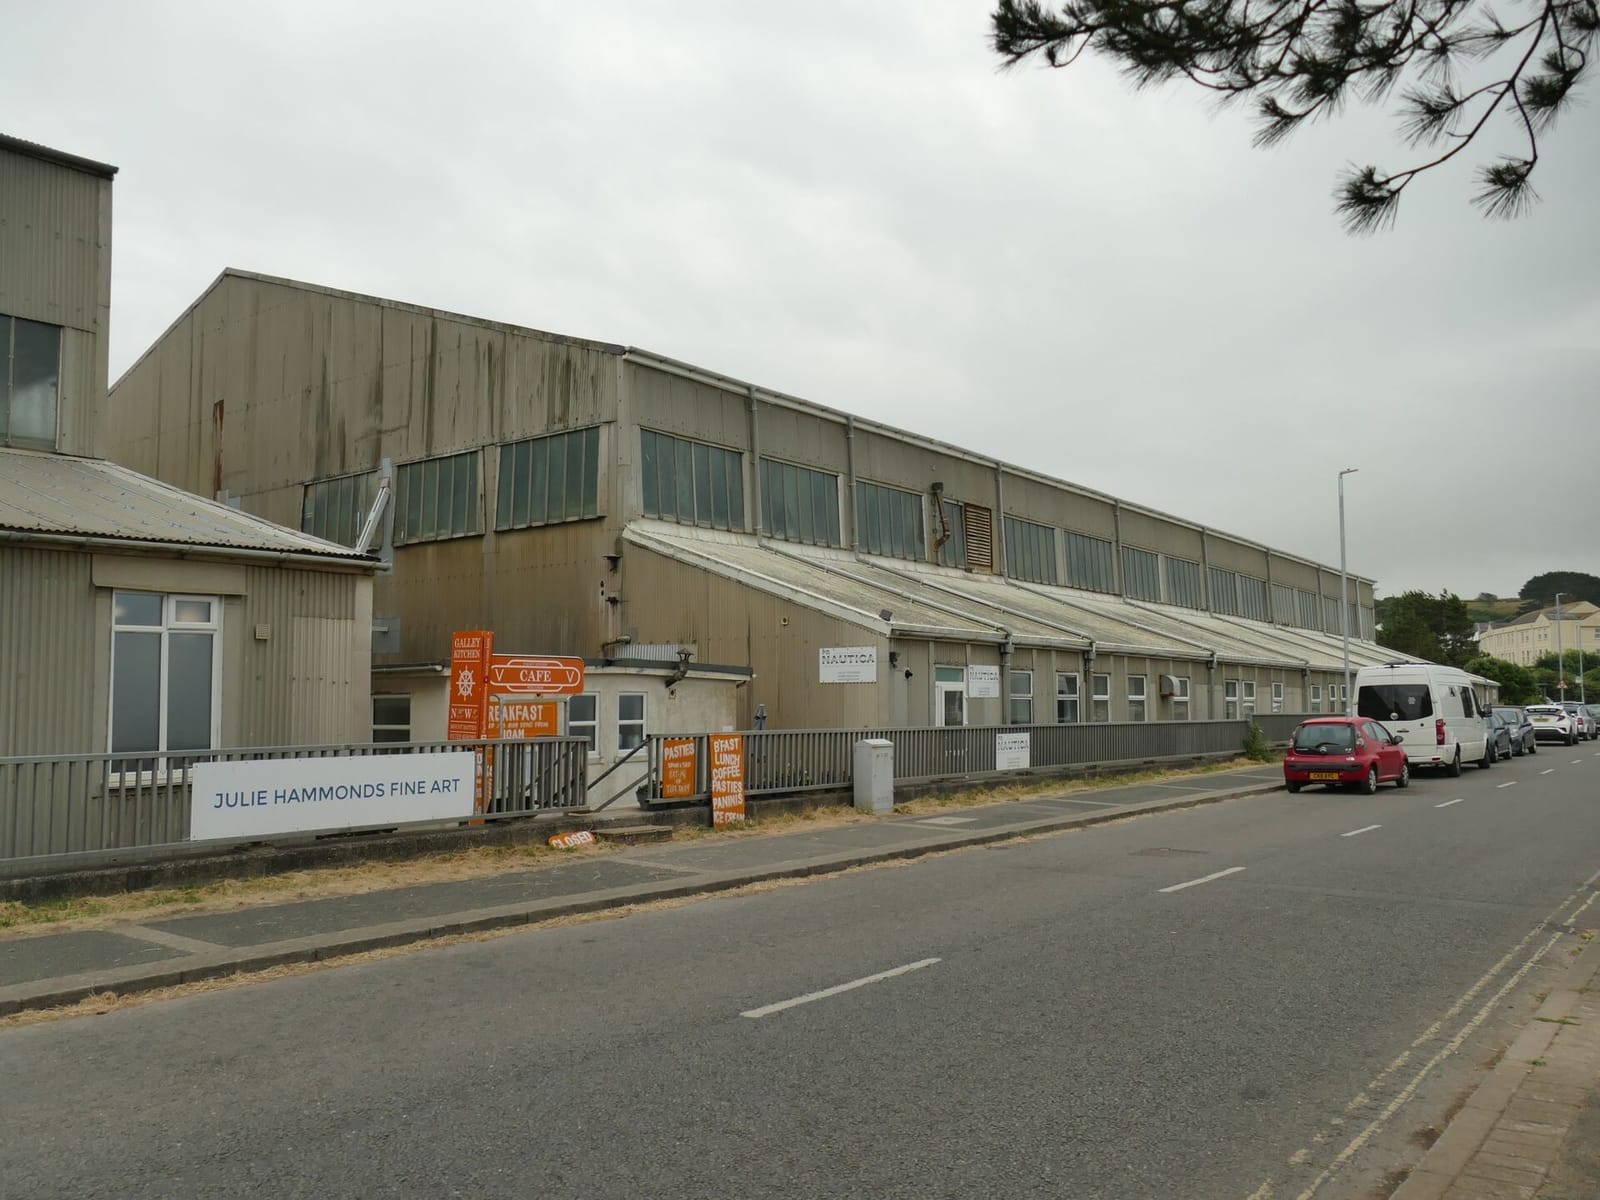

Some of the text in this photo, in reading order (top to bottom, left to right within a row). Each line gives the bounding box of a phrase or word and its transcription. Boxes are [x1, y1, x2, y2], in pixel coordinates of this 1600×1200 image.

[454, 637, 481, 648] GALLEY
[453, 649, 480, 659] KITCHEN
[821, 654, 875, 665] NAUTICA
[519, 669, 552, 682] CAFE
[488, 704, 544, 721] REAKFAST
[664, 743, 694, 759] PASTIES
[715, 753, 740, 766] LUNCH
[712, 767, 740, 779] COFFEE
[213, 778, 461, 808] JULIE HAMMONDS FINE ART
[712, 781, 743, 793] PASTIES
[552, 831, 593, 849] CLOSED
